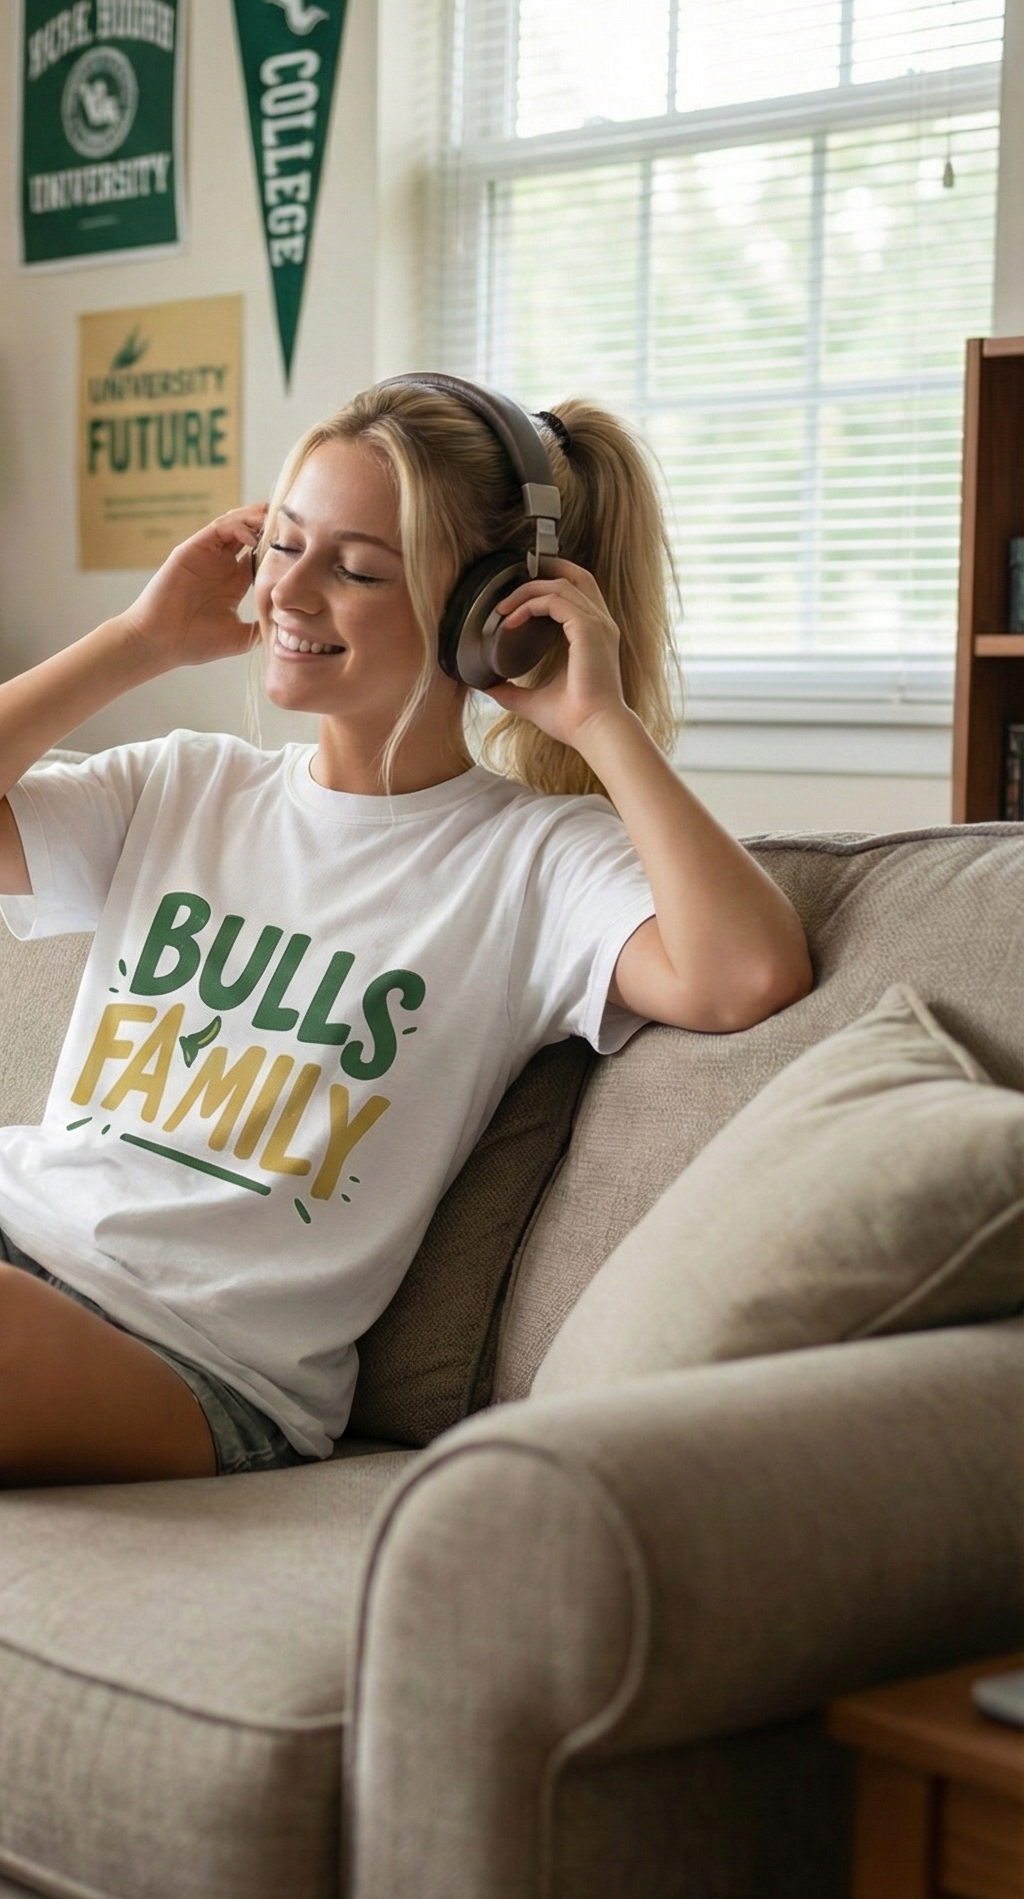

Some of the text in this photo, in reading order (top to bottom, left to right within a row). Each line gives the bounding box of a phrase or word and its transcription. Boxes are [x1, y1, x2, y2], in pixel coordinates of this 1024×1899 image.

[29, 153, 171, 214] UNIVERSITY
[259, 50, 321, 267] COLLEGE
[87, 366, 225, 404] UNIVERSITY
[87, 408, 228, 476] FUTURE
[129, 891, 426, 1081] BULLS
[70, 1003, 392, 1201] FAMILY
